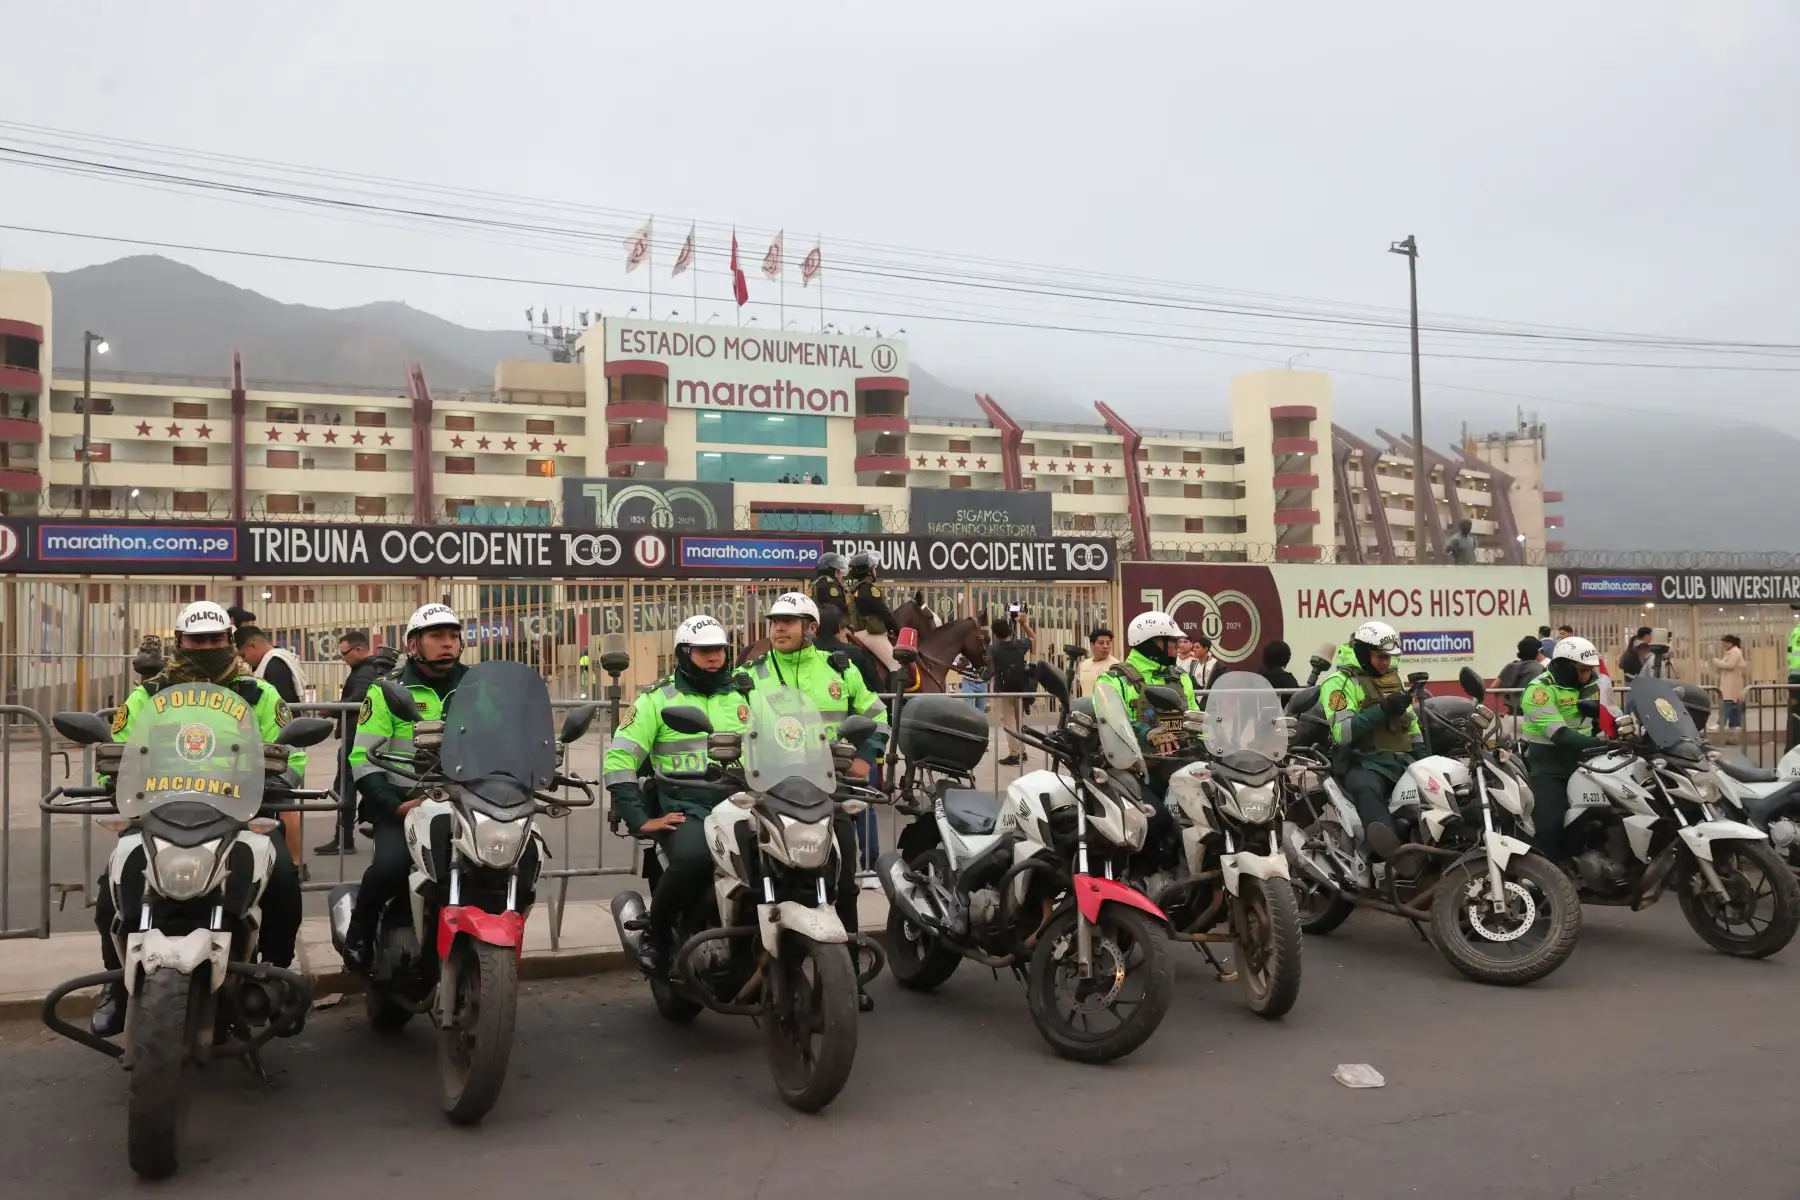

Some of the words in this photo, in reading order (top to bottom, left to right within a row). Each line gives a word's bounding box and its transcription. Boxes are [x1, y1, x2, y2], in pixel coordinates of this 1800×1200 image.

[620, 328, 716, 357] ESTADIO
[724, 336, 863, 369] MONUMENTAL
[676, 378, 849, 412] marathon
[956, 509, 1009, 522] SIGAMOS
[47, 533, 229, 556] marathon.com.pe
[250, 527, 369, 563] TRIBUNA
[381, 530, 552, 566] OCCIDENTE
[686, 543, 818, 563] marathon.com.pe
[929, 541, 1057, 571] OCCIDENTE
[1581, 580, 1653, 593] marathon.com.pe
[1661, 575, 1706, 600] CLUB
[1711, 576, 1800, 599] UNIVERSITAR
[1298, 588, 1423, 618] HAGAMOS
[1431, 588, 1532, 617] HISTORIA
[184, 611, 225, 628] POLICIA
[1402, 634, 1472, 652] marathon
[153, 689, 248, 721] POLICIA
